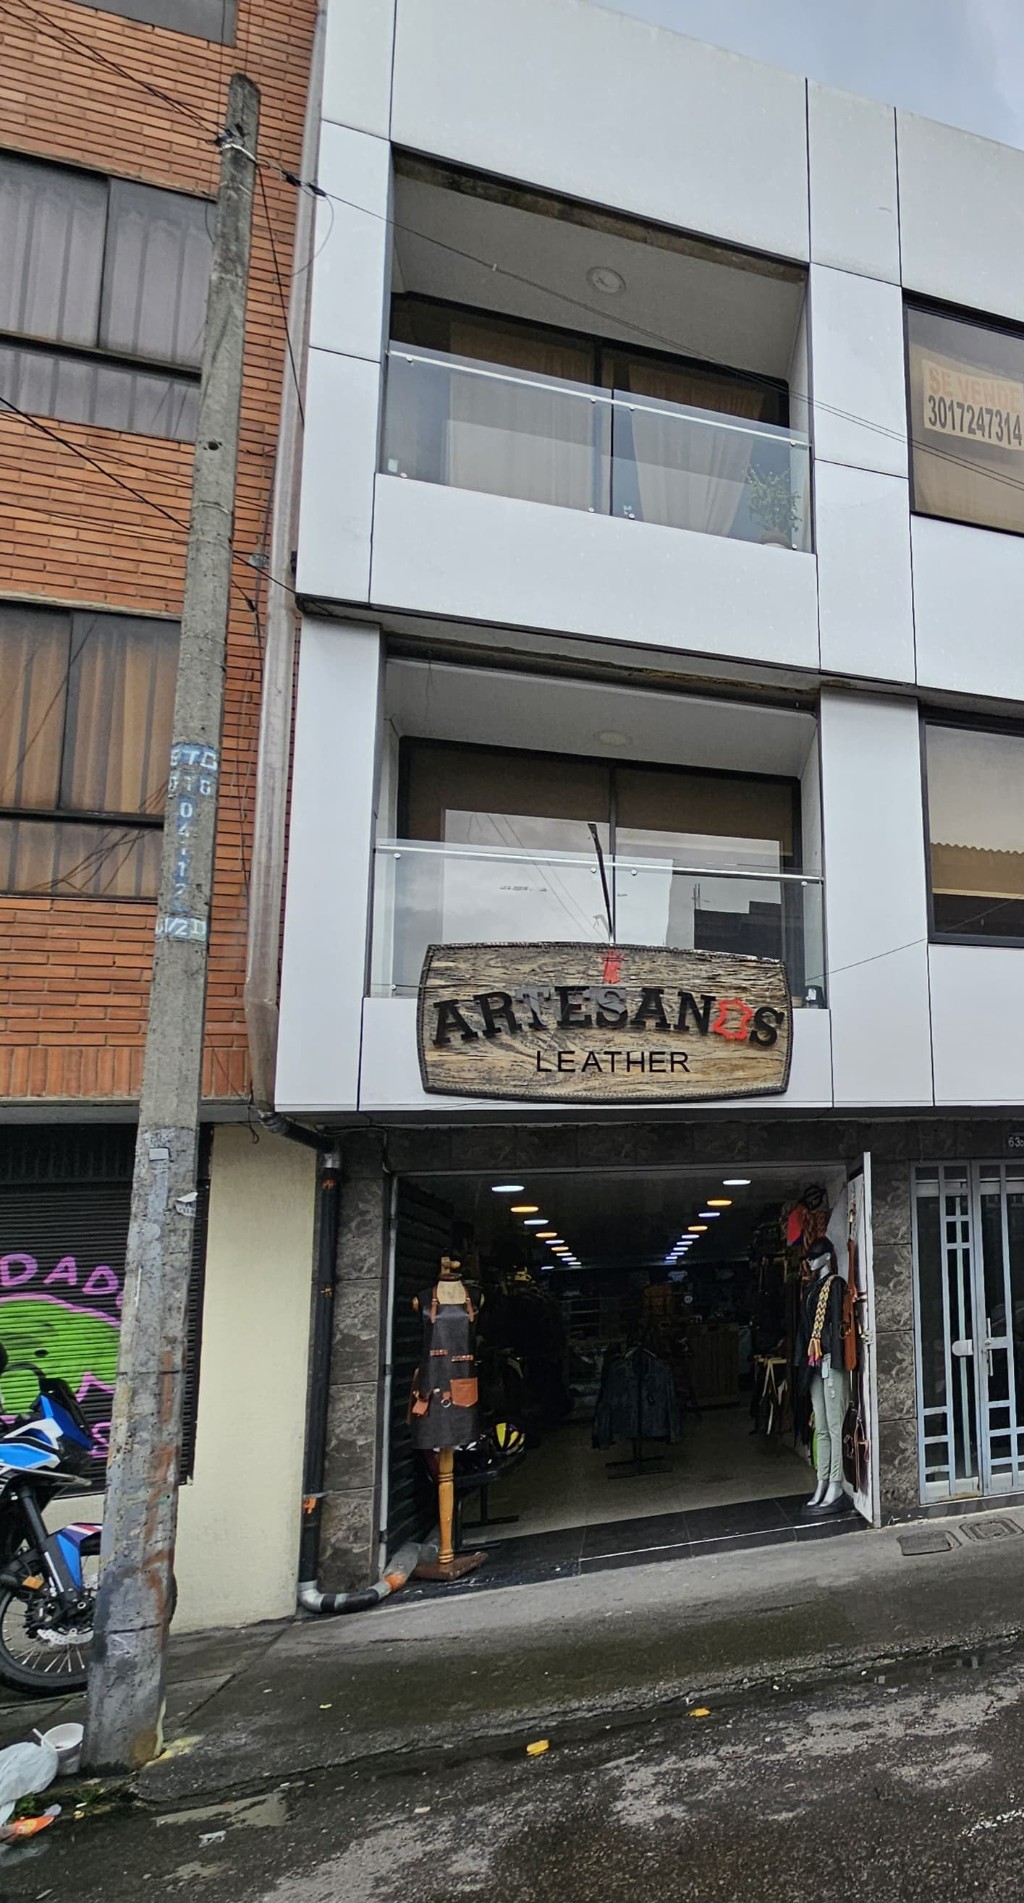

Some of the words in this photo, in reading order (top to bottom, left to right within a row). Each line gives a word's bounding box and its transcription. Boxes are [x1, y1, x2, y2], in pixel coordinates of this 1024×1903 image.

[928, 394, 1022, 446] 3017247314
[432, 985, 785, 1047] ARTESANOS
[536, 1050, 690, 1073] LEATHER
